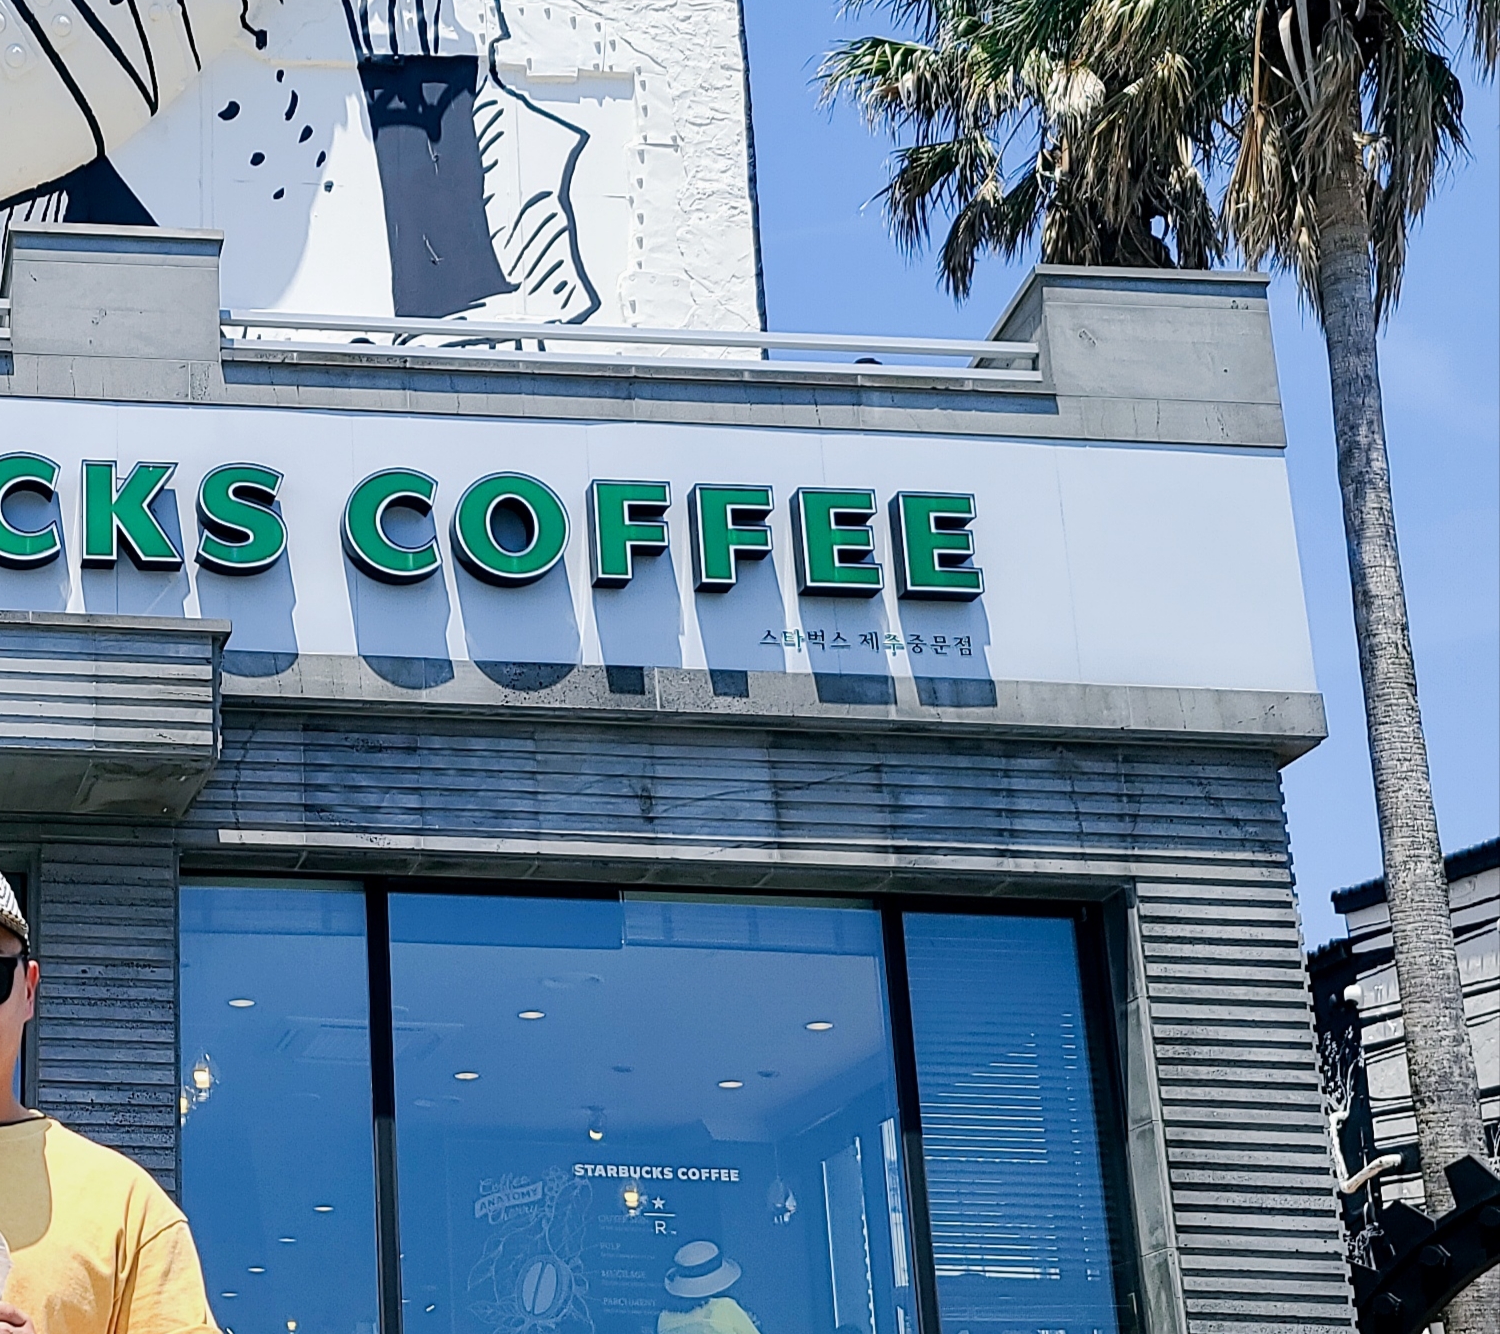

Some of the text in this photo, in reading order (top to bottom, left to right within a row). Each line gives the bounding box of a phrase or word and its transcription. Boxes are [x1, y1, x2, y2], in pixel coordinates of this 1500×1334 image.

[340, 466, 986, 602] COFFEE
[759, 629, 973, 656] 스타벅스 제주중문점
[574, 1164, 739, 1181] STARBUCKS COFFEE
[654, 1221, 667, 1234] R
